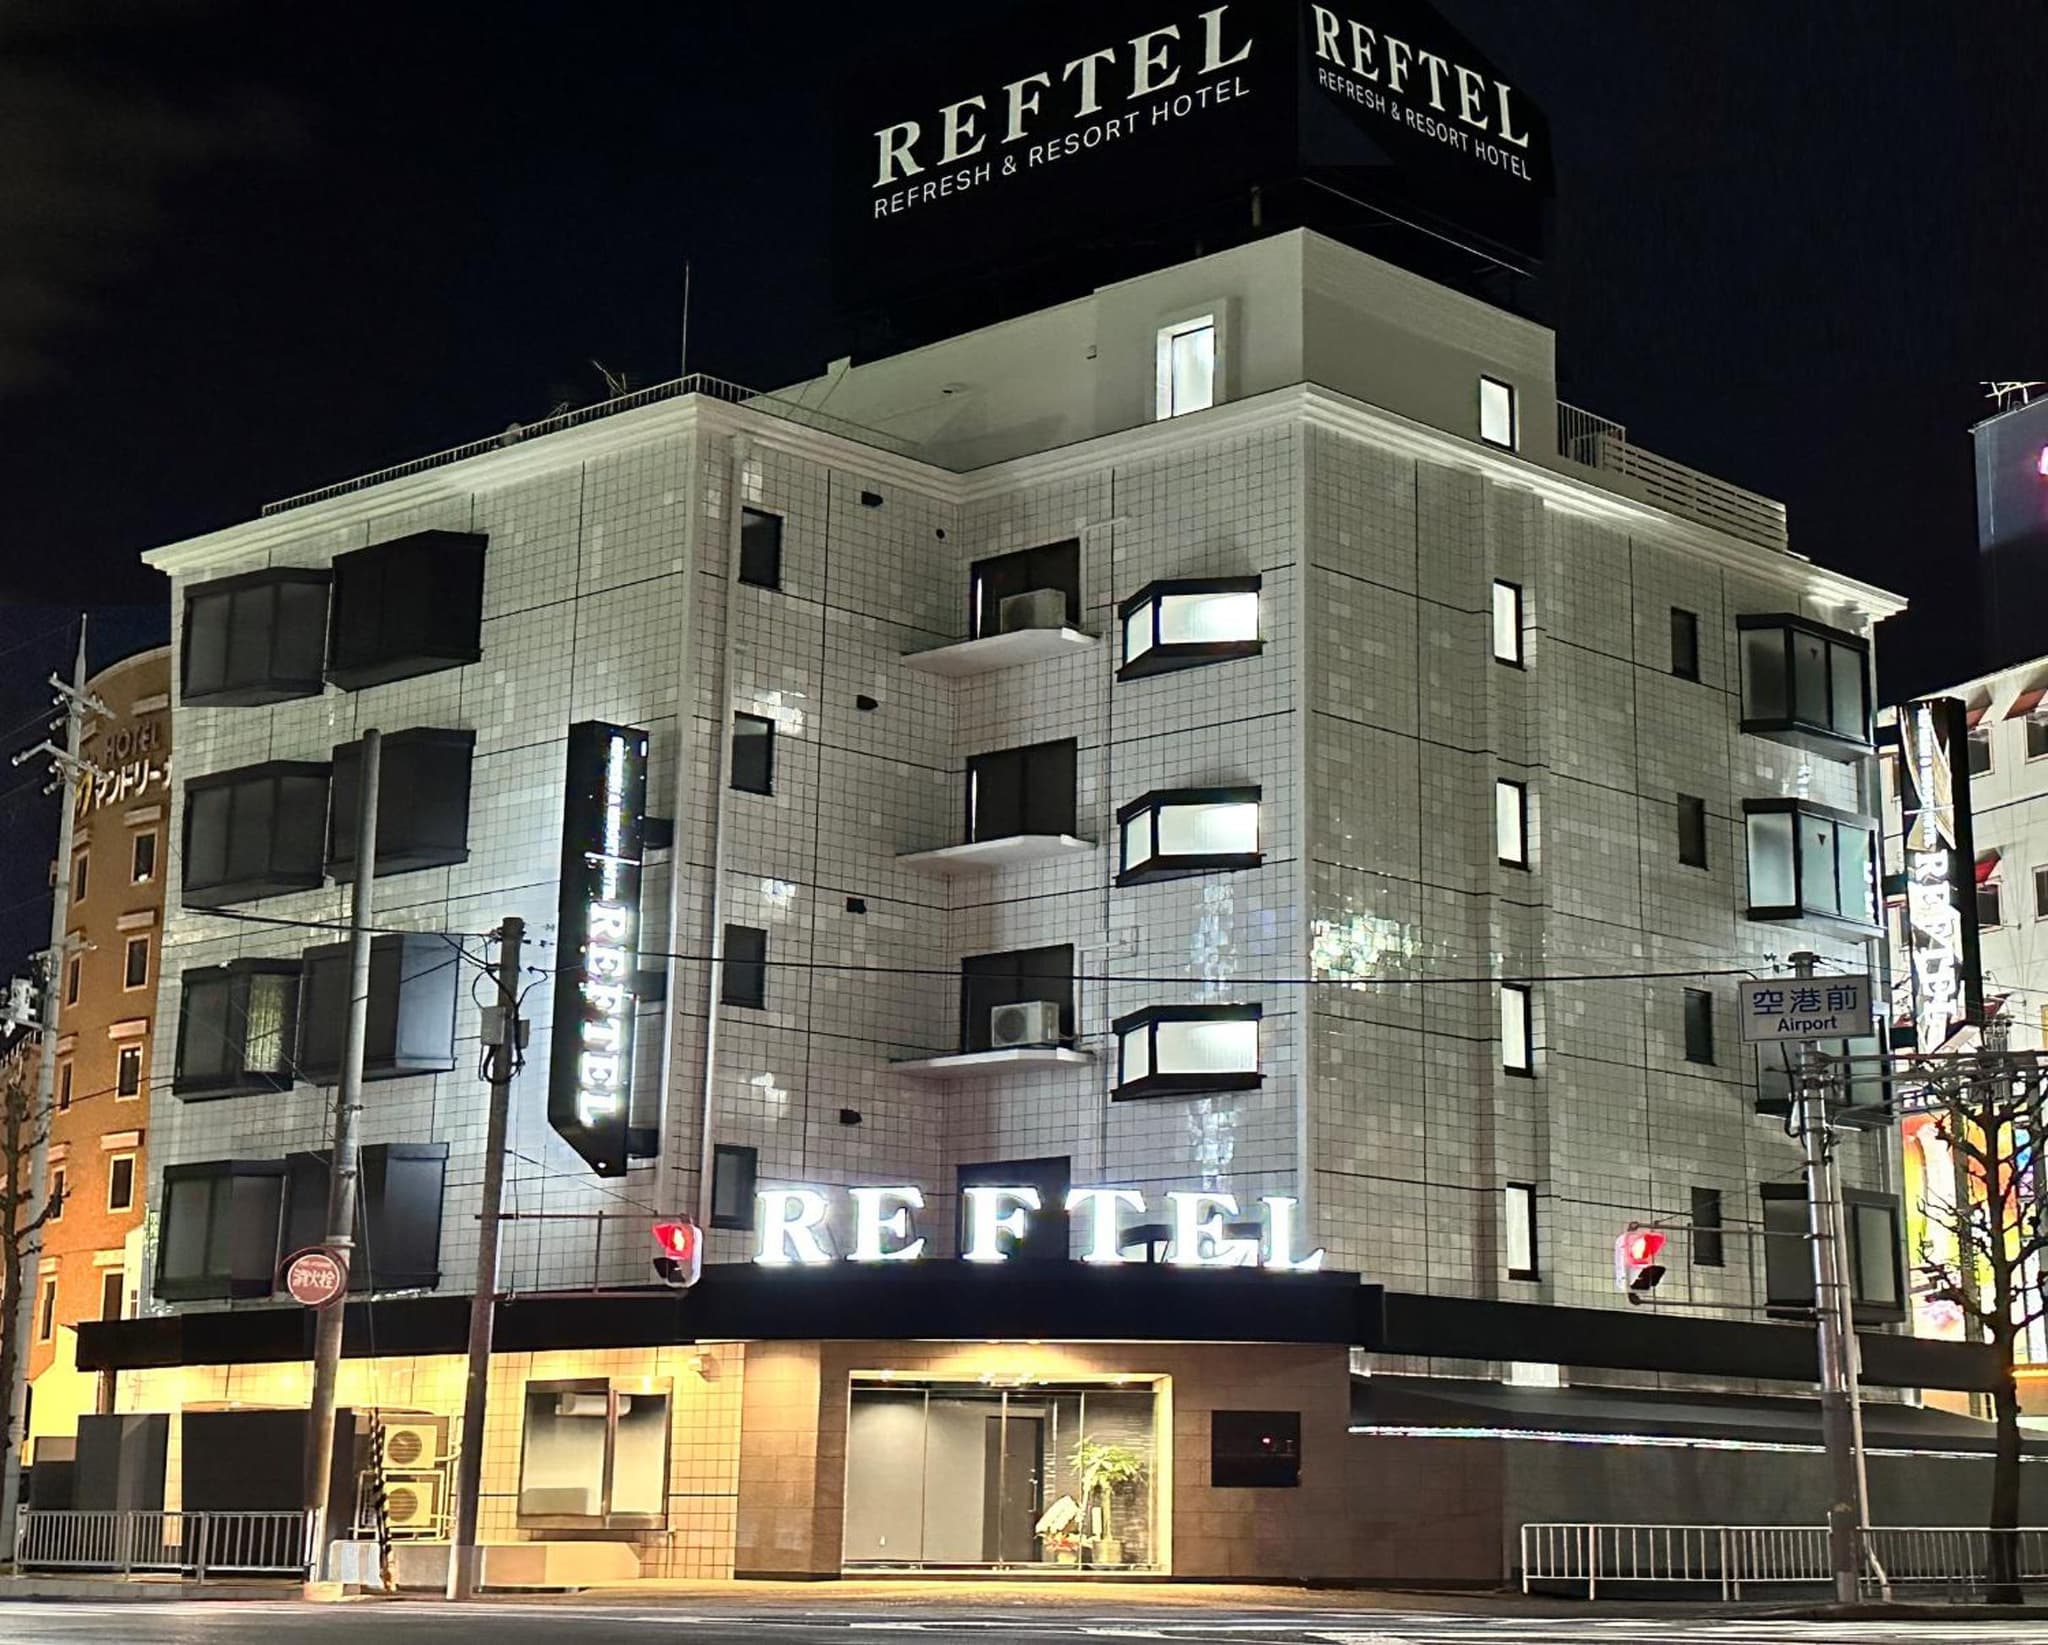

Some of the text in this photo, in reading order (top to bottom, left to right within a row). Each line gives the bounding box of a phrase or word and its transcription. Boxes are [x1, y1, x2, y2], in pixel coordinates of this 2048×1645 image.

[872, 5, 1253, 189] REFTEL
[1312, 4, 1529, 148] REFTEL
[1318, 67, 1532, 182] REFRESH & RESORT HOTEL
[874, 76, 1250, 218] REFRESH & RESORT HOTEL
[103, 720, 160, 760] HOTEL
[578, 901, 627, 1127] REFTEL
[1752, 984, 1858, 1016] 空港前
[1777, 1016, 1838, 1033] Airport
[753, 1186, 1324, 1271] REFTEL
